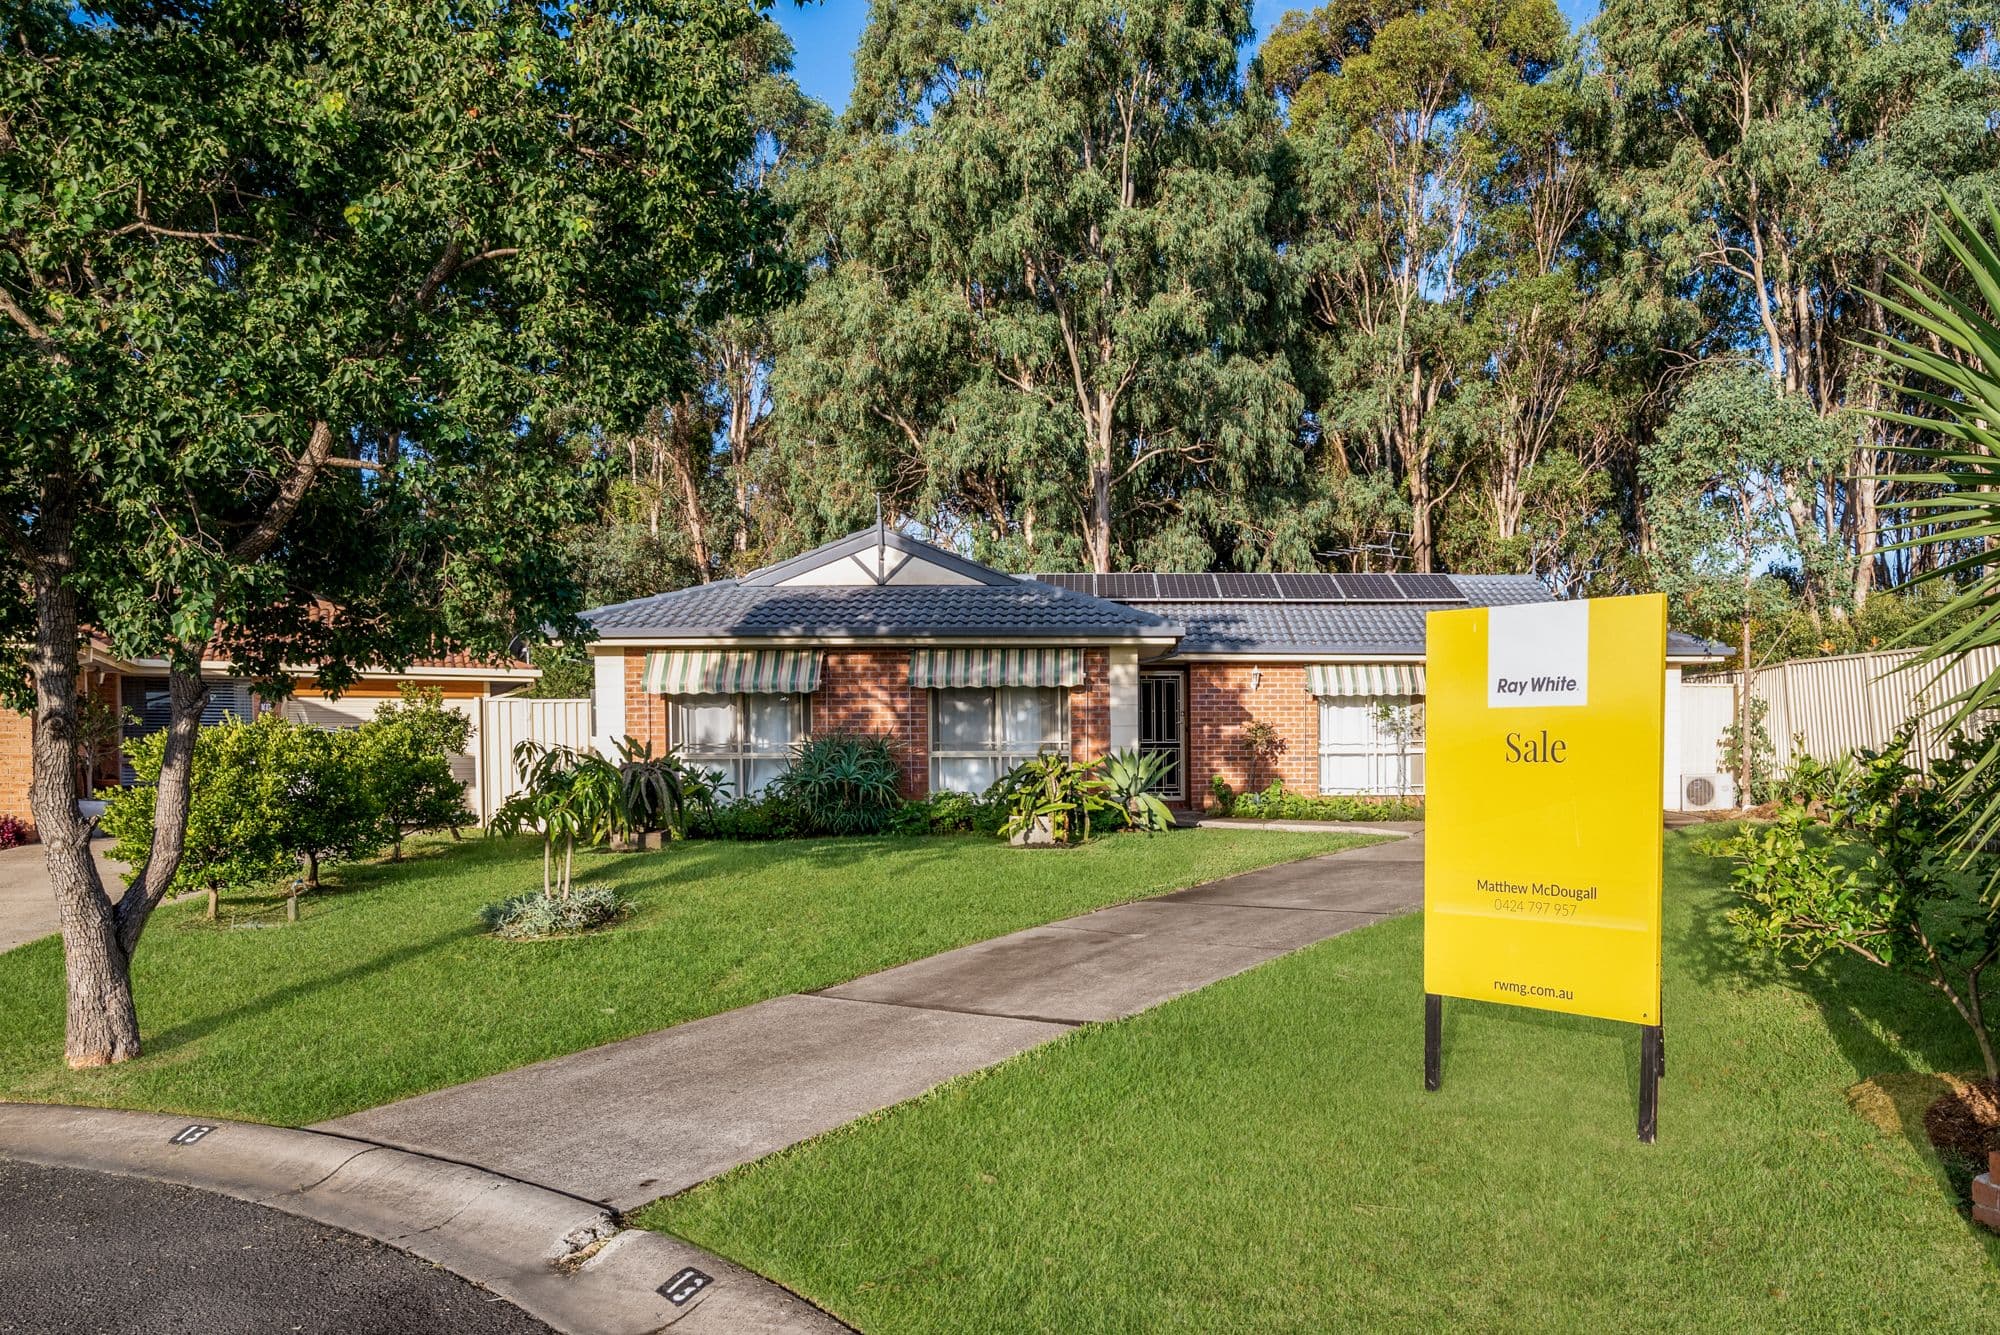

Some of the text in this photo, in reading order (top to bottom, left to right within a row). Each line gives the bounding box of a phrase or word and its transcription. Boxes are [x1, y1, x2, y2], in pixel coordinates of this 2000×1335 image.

[1497, 676, 1577, 696] Ray White
[1506, 730, 1567, 763] Sale
[1477, 879, 1597, 901] Matthew McDougall
[1494, 898, 1577, 917] 0424 797 957
[1494, 980, 1574, 1000] rwmg.com.au
[176, 1126, 210, 1143] 13
[666, 1270, 704, 1302] 13
